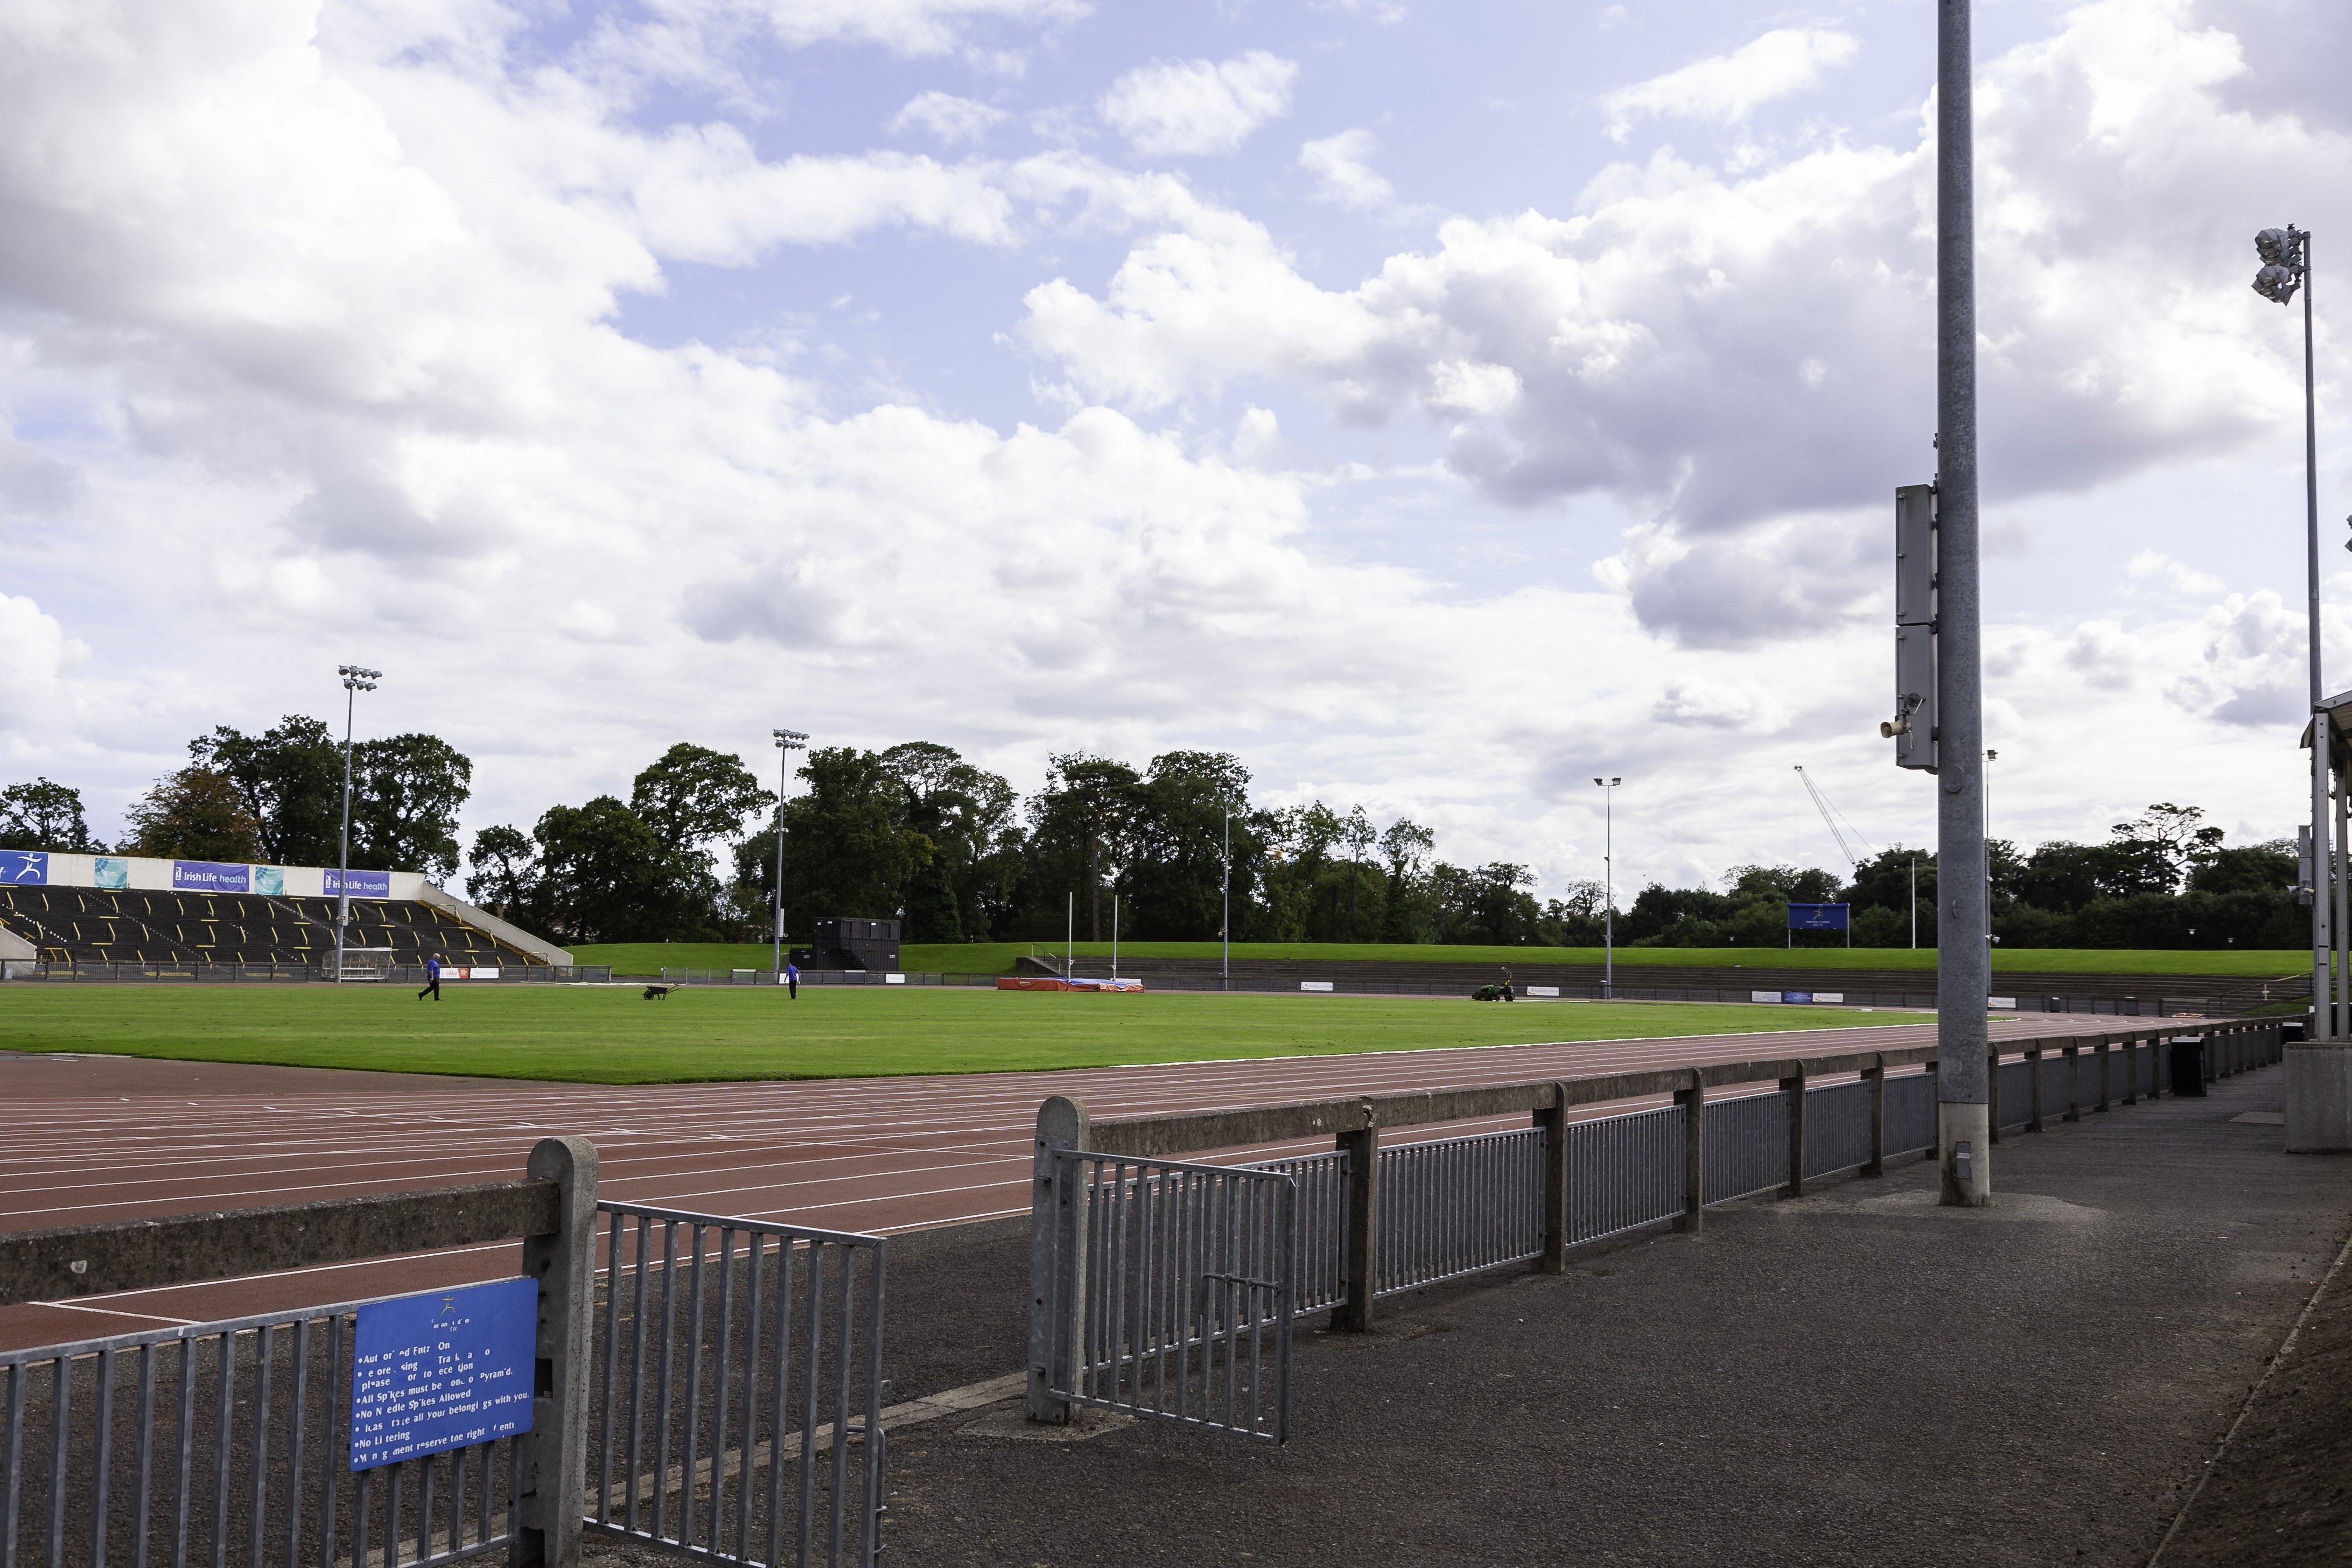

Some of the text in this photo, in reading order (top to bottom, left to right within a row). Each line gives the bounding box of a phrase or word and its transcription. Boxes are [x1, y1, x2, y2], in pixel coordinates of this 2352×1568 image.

[184, 872, 247, 883] Irish Life health
[333, 880, 387, 890] Irih Life health
[438, 1353, 460, 1364] Trak
[361, 1395, 374, 1404] All
[377, 1390, 405, 1403] Spkes
[408, 1384, 429, 1395] must
[431, 1382, 442, 1390] be
[480, 1367, 513, 1382] Pyramd.
[361, 1389, 471, 1419] No Nedle Spkes Allowed
[414, 1412, 424, 1423] all
[426, 1410, 446, 1420] your
[449, 1399, 492, 1415] belongigs
[495, 1395, 511, 1405] with
[513, 1392, 529, 1403] you.
[360, 1431, 410, 1448] No Litering
[467, 1427, 485, 1440] right
